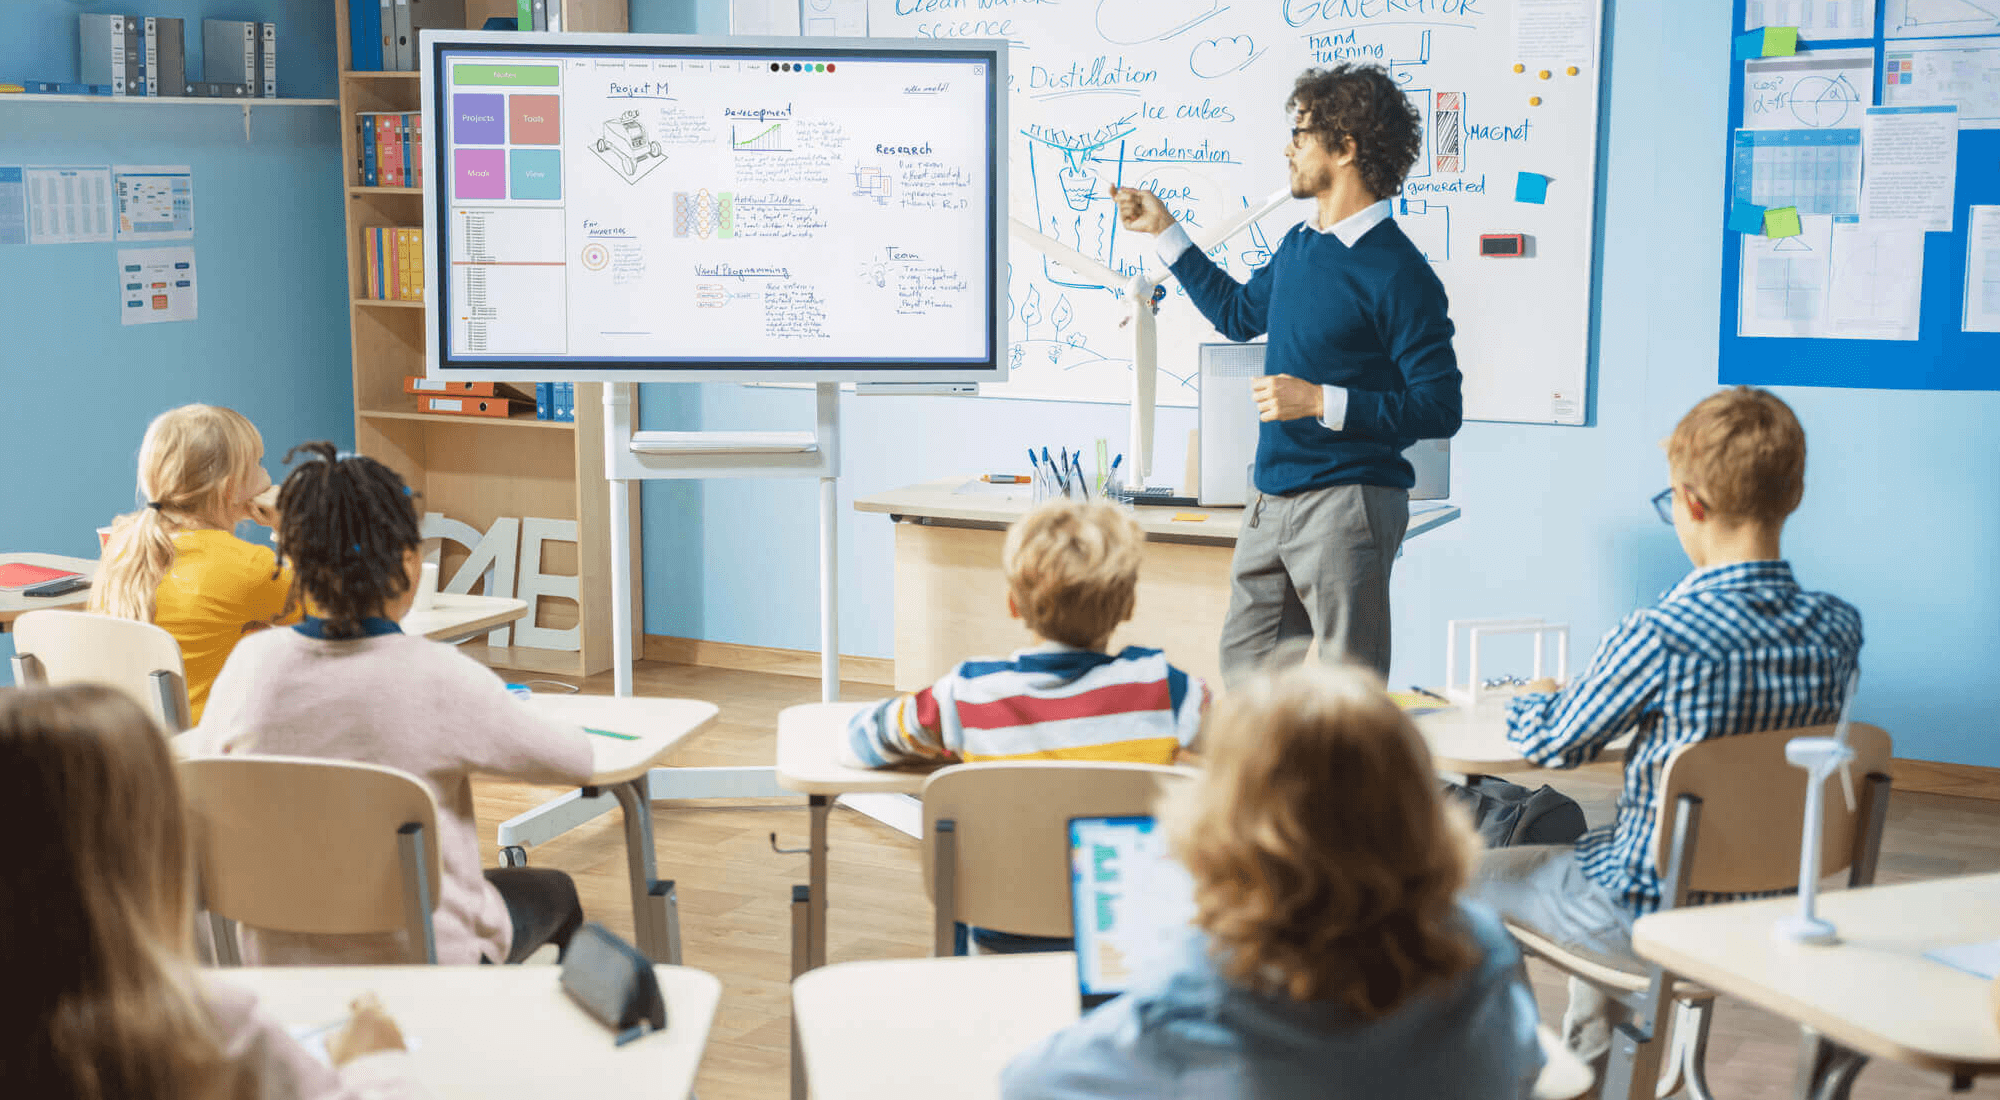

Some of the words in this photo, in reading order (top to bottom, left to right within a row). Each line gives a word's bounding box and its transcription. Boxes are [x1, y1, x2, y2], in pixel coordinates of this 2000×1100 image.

[917, 19, 1018, 40] science
[1309, 29, 1357, 50] hand
[1029, 55, 1158, 89] Distillation
[610, 82, 651, 98] Project
[656, 82, 669, 95] M
[461, 113, 495, 124] Projects
[523, 114, 545, 124] Tools
[1141, 101, 1169, 120] Ice
[1176, 98, 1236, 123] cubes
[885, 245, 920, 261] Team
